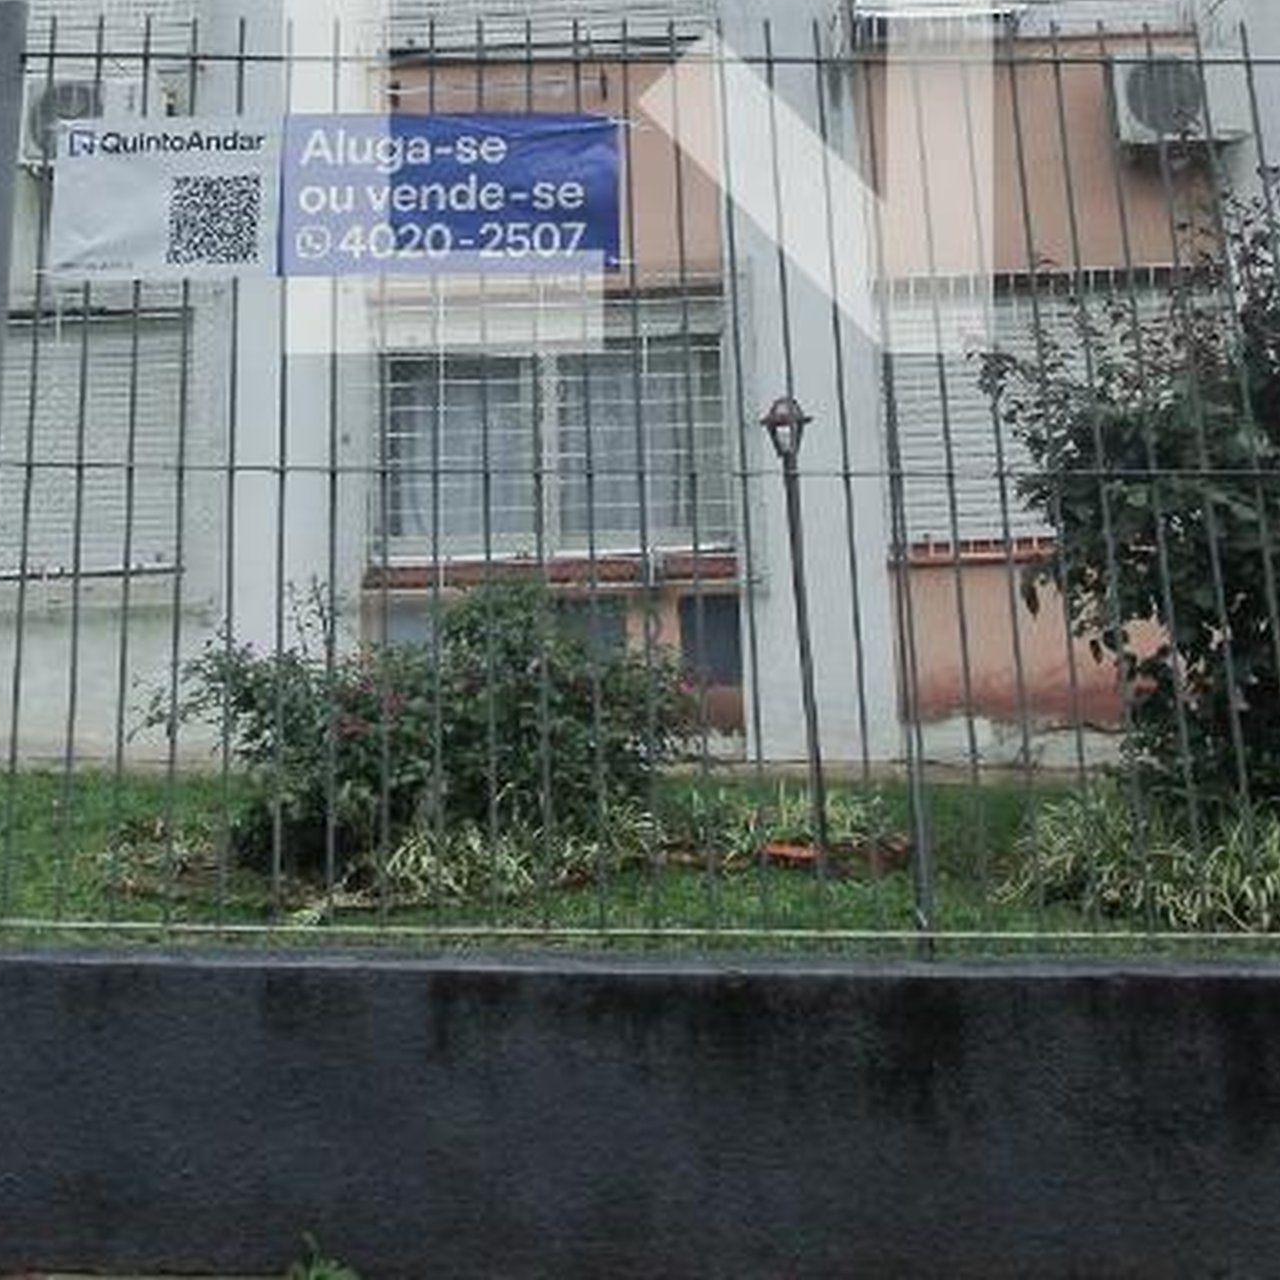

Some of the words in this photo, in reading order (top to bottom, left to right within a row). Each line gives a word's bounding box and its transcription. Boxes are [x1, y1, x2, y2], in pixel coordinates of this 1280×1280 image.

[99, 132, 265, 155] QuintoAndar
[300, 129, 508, 173] Aluga-se
[299, 184, 355, 213] ou
[366, 176, 585, 212] vende-se
[338, 223, 587, 258] 4020-2507
